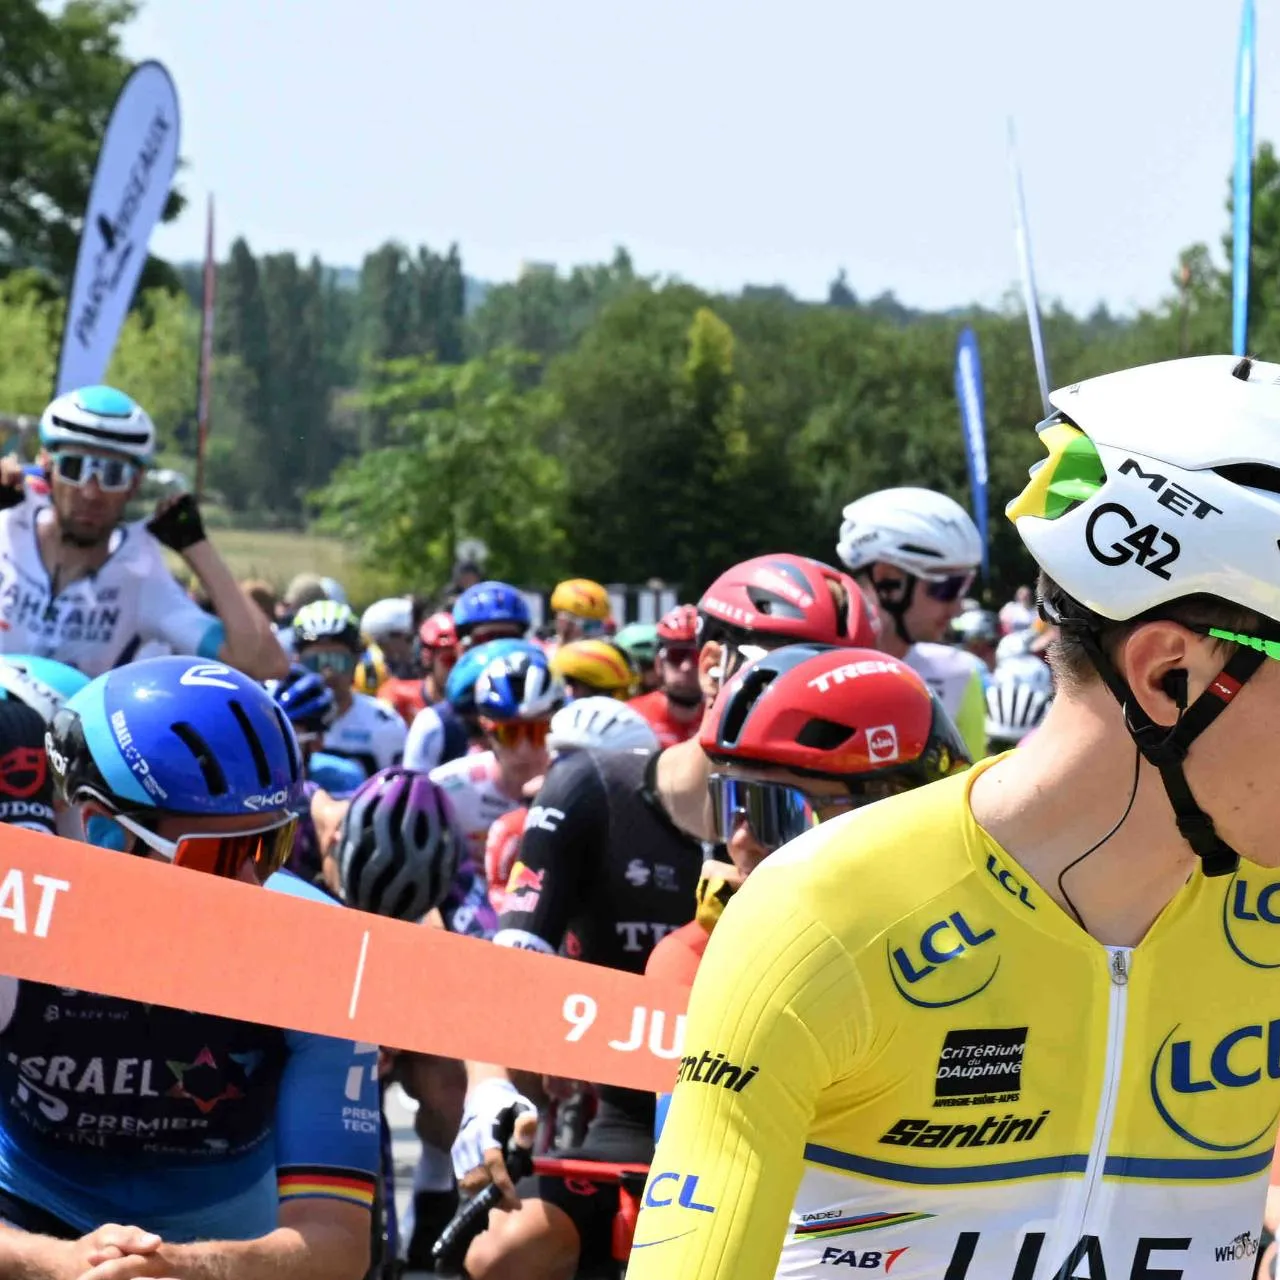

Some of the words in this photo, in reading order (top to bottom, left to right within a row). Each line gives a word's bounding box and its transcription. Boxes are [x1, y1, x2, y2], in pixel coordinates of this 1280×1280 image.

[1118, 458, 1223, 519] MET
[1085, 503, 1180, 581] G42
[808, 661, 901, 692] TREK
[986, 854, 1036, 911] LCL
[893, 911, 997, 984] LCL
[562, 994, 598, 1041] 9
[967, 1058, 981, 1066] du
[879, 1110, 1050, 1149] Santini
